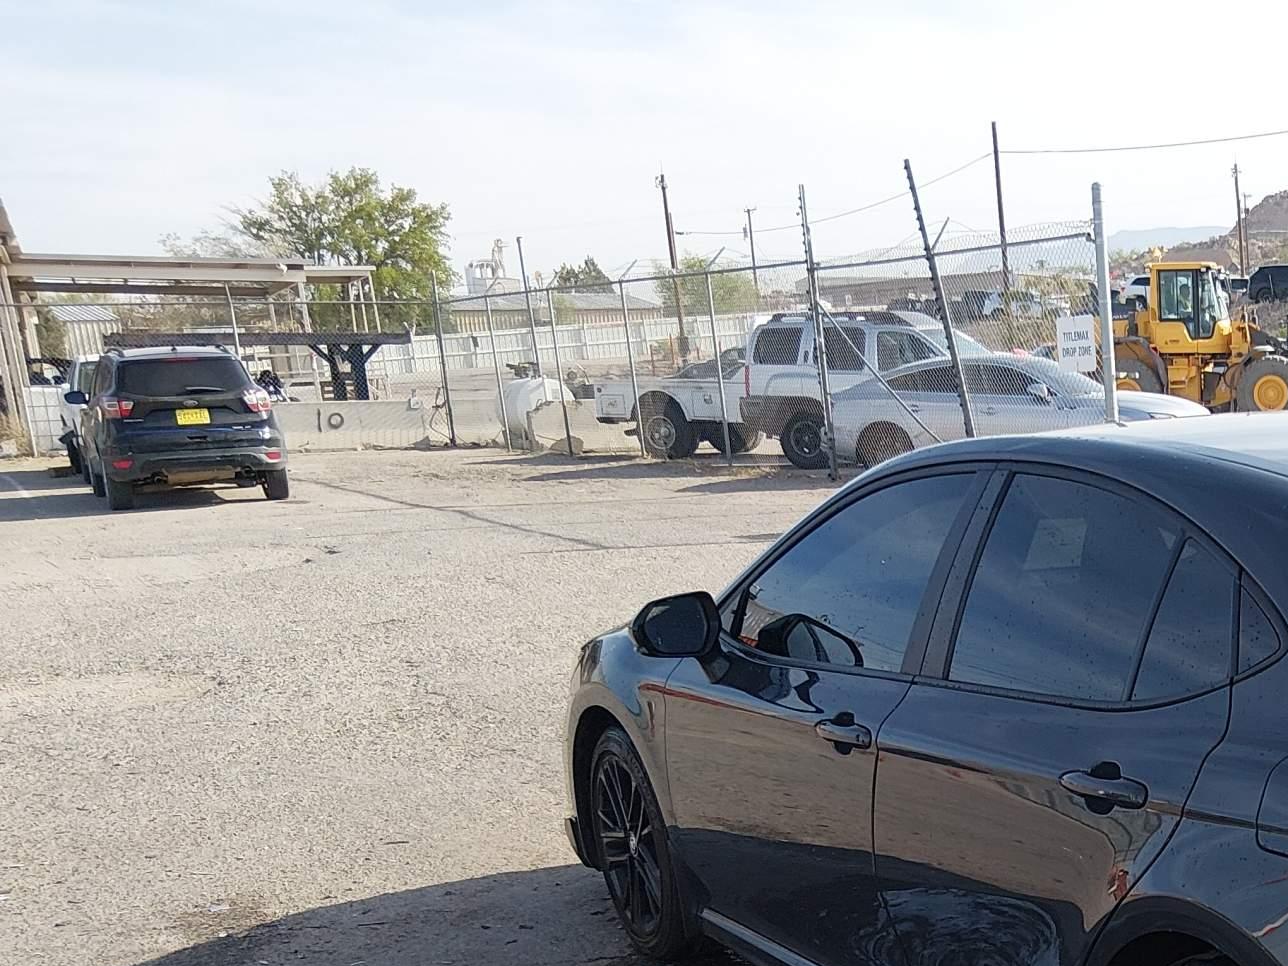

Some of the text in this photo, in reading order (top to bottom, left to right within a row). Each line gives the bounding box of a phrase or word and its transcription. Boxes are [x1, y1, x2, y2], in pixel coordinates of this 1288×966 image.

[1062, 330, 1090, 342] TITLEMAX
[1062, 345, 1092, 358] DROP ZONE
